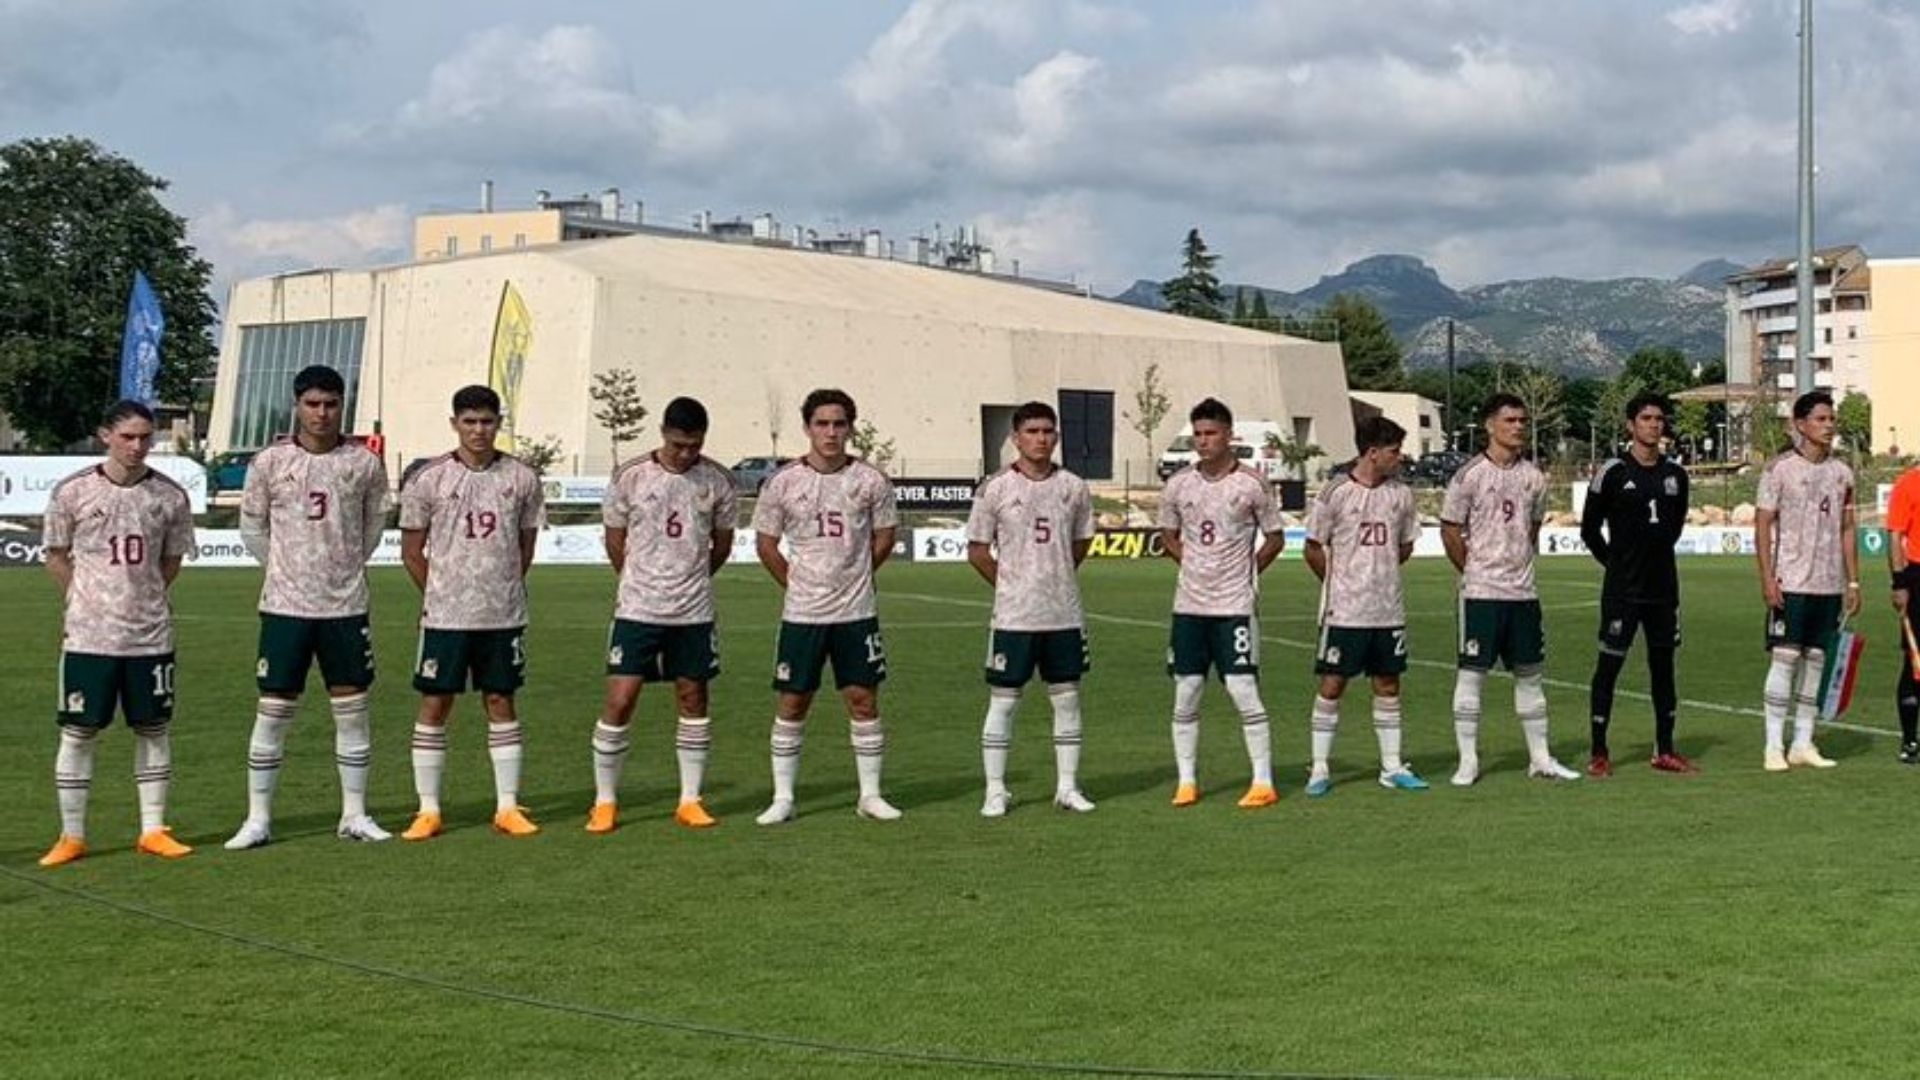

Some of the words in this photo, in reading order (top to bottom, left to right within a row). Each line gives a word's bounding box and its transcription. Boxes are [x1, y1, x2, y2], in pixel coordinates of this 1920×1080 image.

[307, 492, 327, 521] 3
[1502, 500, 1514, 523] 9
[1648, 499, 1659, 524] 1
[1820, 495, 1830, 517] 4
[465, 510, 496, 539] 19
[666, 511, 682, 538] 6
[816, 511, 843, 538] 15
[1035, 517, 1050, 544] 5
[1201, 520, 1216, 546] 8
[1359, 522, 1388, 547] 20
[109, 534, 144, 565] 10
[1233, 626, 1250, 652] 8
